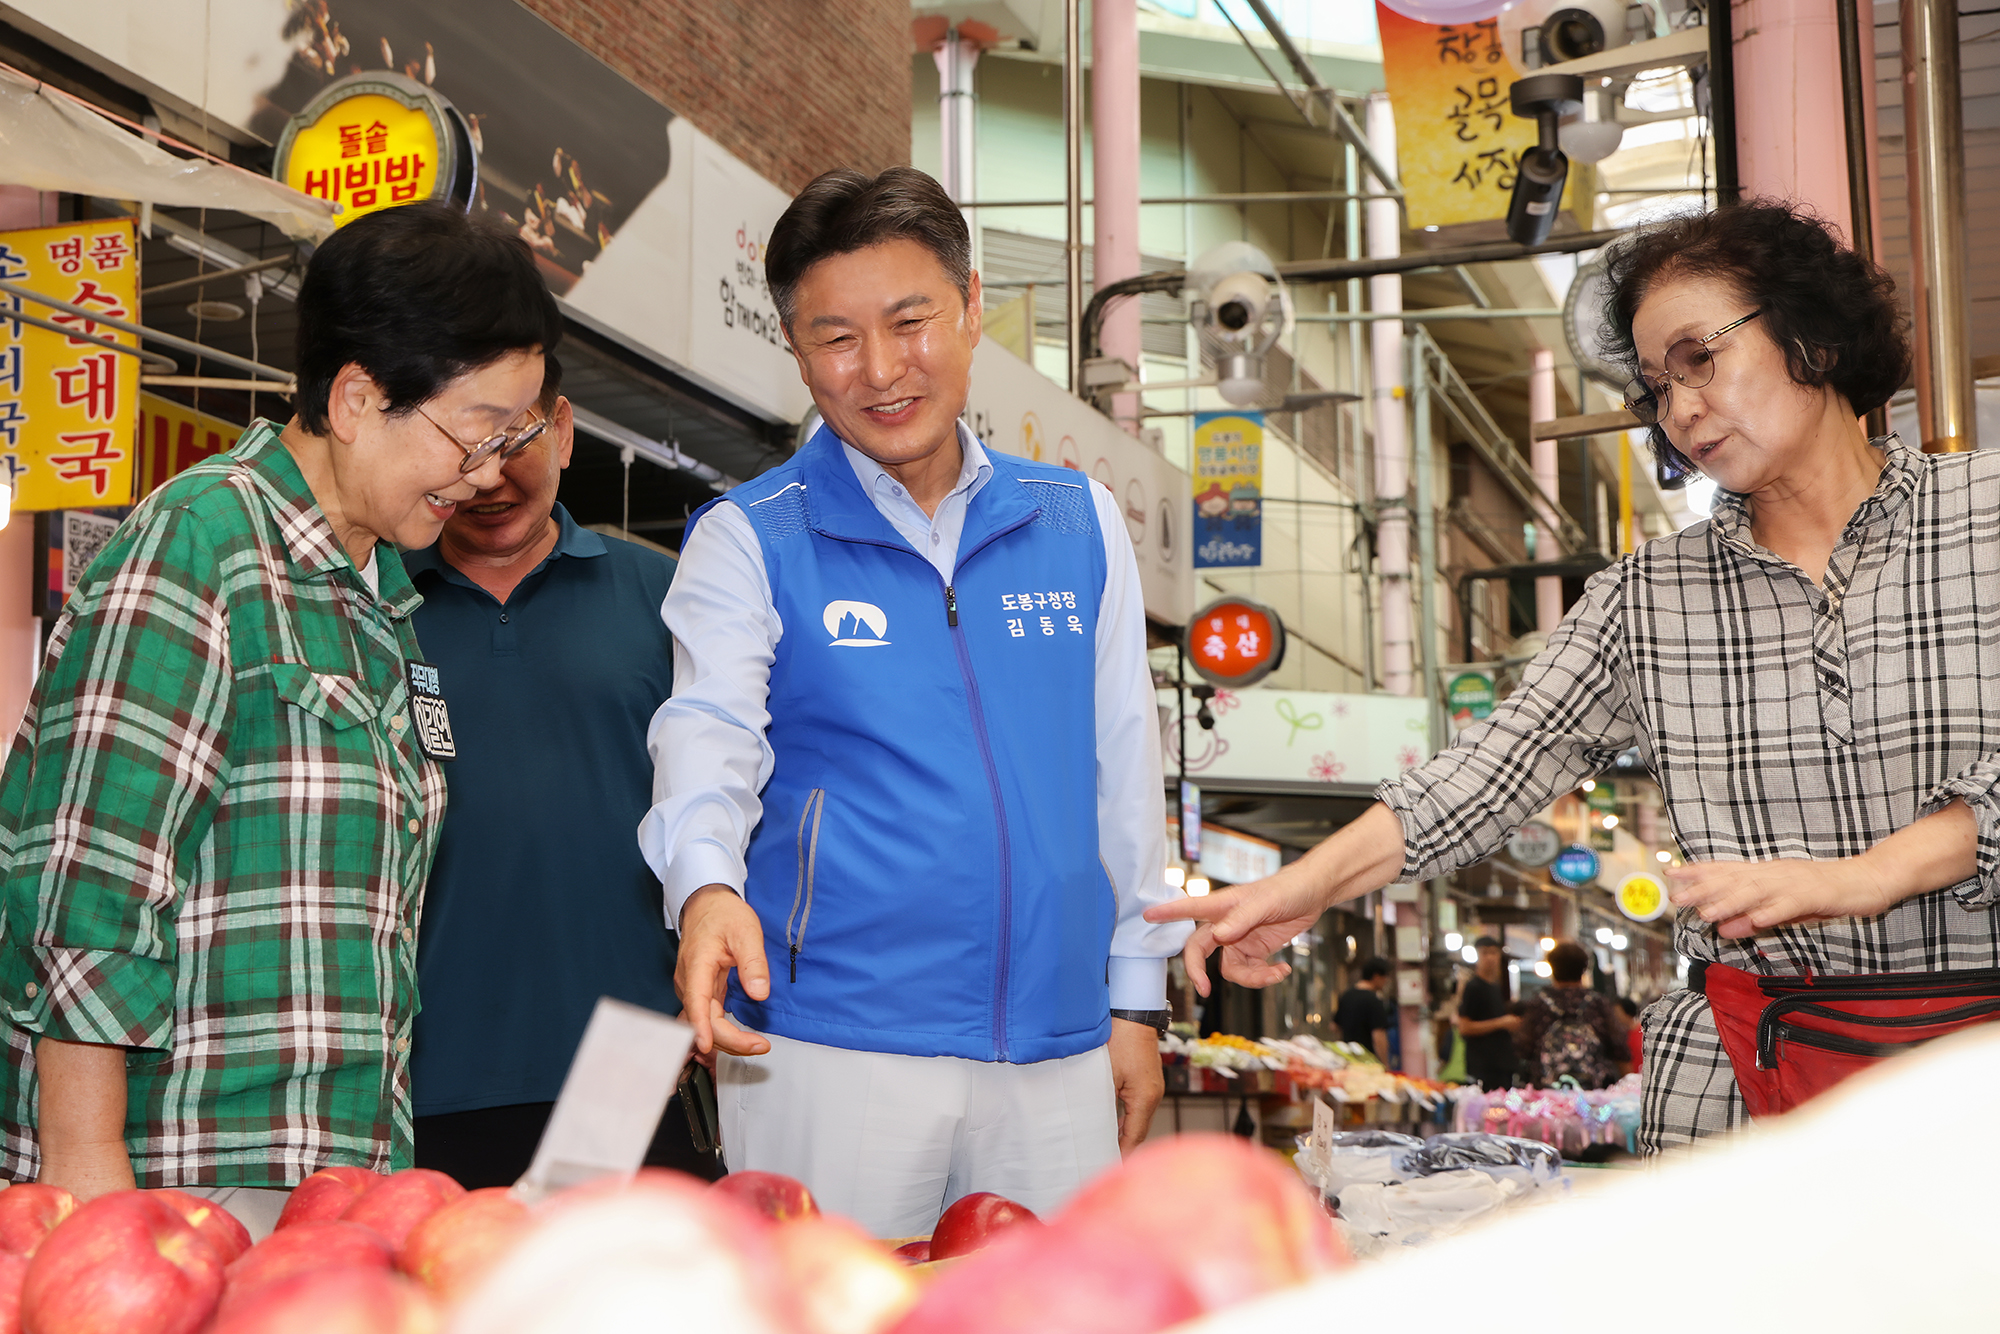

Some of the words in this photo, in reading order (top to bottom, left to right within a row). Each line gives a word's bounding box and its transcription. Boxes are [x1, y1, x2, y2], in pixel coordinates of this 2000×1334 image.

[1448, 77, 1510, 142] 골목
[339, 120, 389, 159] 돌솥
[305, 154, 425, 208] 비빔밥
[1452, 148, 1522, 190] 시장
[49, 234, 131, 273] 명품
[51, 282, 126, 495] 순대국
[1001, 591, 1077, 611] 도봉구청장
[410, 663, 440, 696] 직무대행
[413, 696, 456, 757] 이길연
